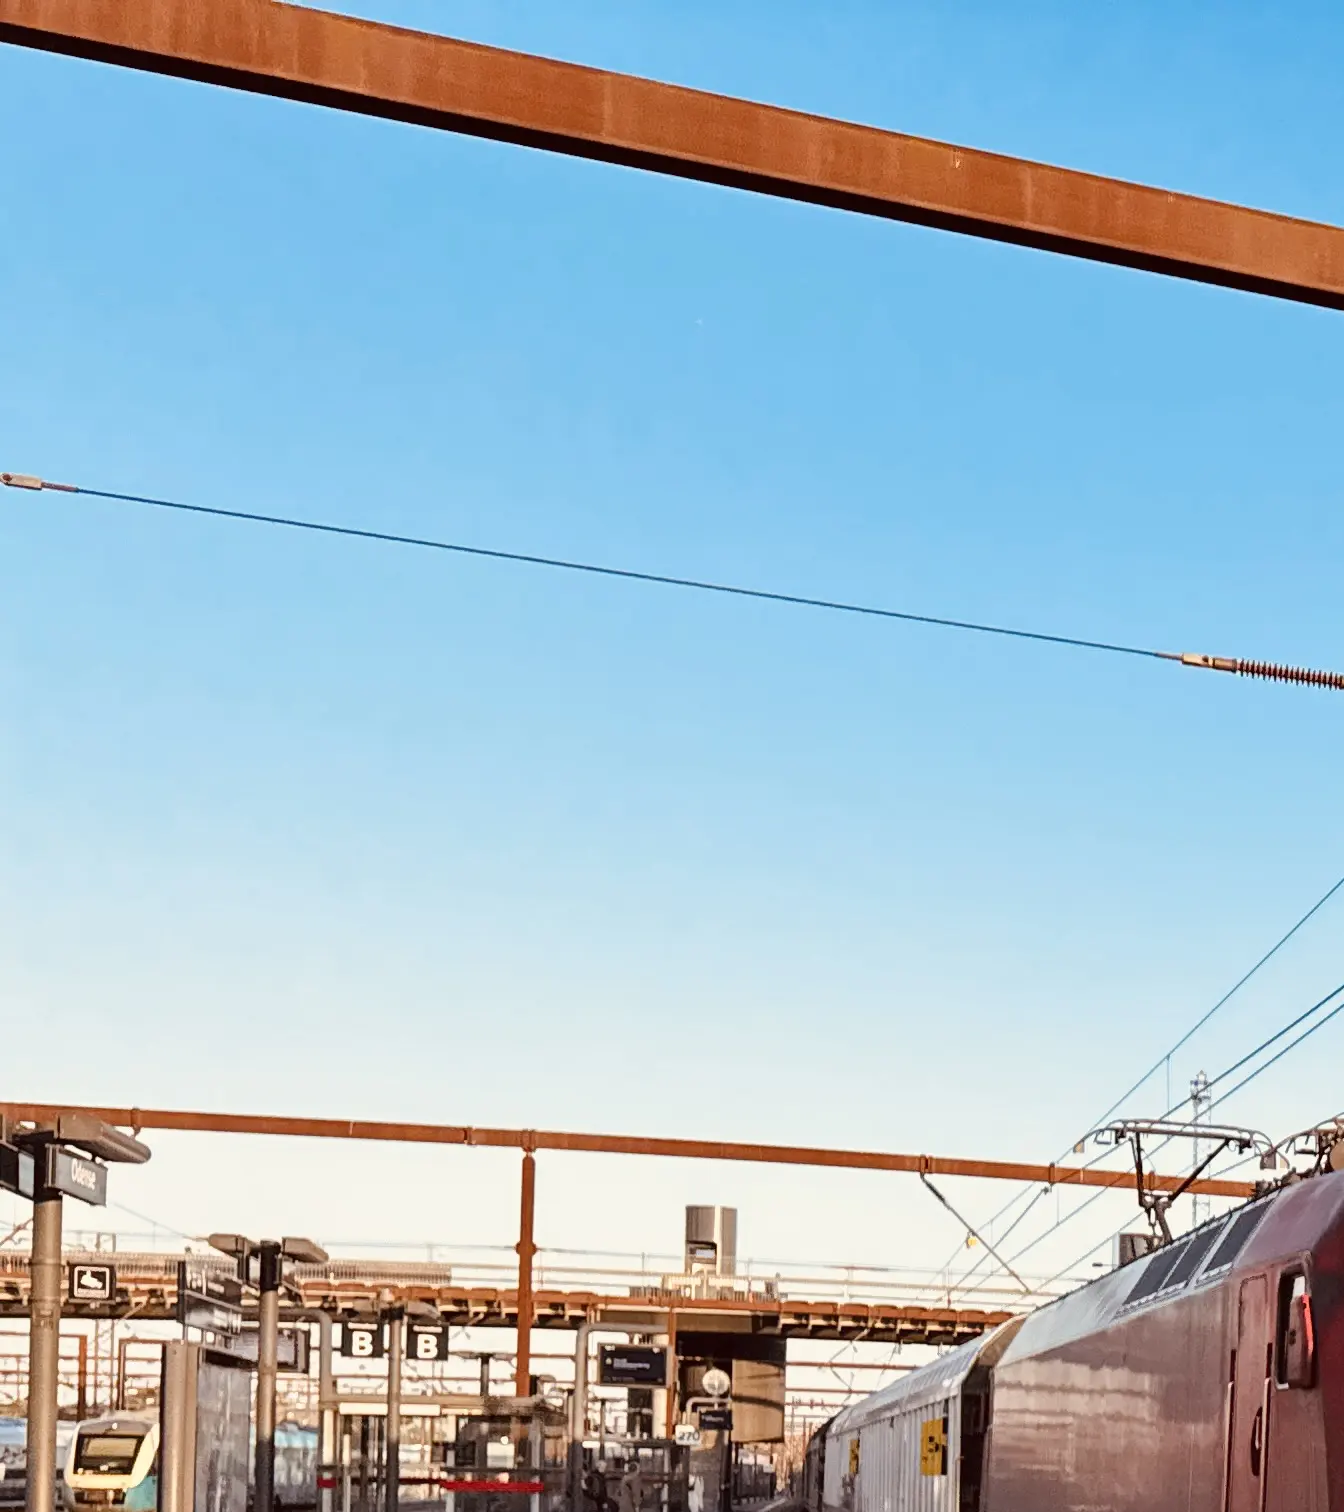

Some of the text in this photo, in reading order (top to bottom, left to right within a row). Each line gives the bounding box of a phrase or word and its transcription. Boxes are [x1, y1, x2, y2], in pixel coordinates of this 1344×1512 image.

[352, 1331, 373, 1356] B
[417, 1334, 438, 1359] B
[679, 1430, 700, 1441] 270
